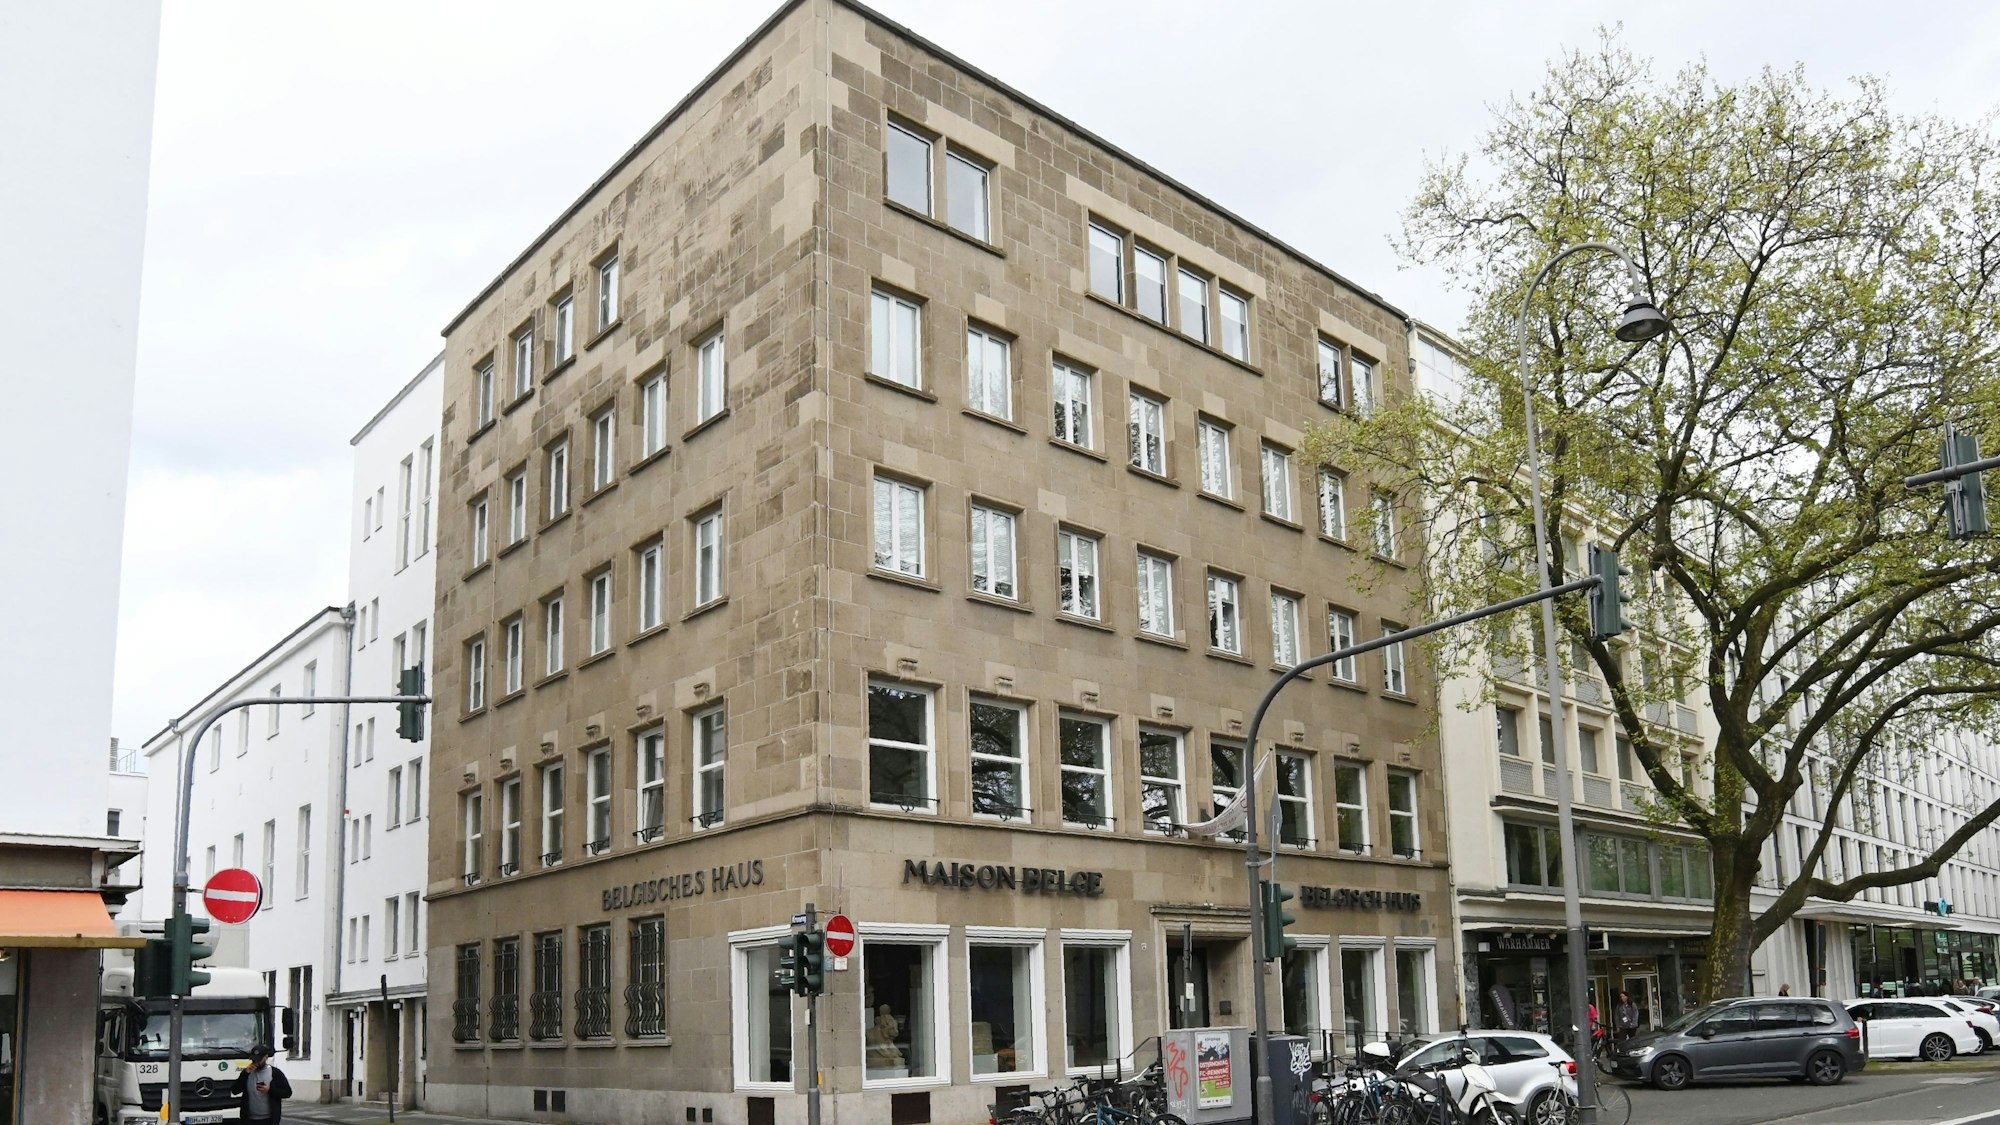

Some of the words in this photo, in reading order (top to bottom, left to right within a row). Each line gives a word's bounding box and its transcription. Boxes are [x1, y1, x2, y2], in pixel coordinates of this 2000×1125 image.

[602, 870, 705, 912] BELGISCHES
[711, 859, 764, 893] HAUS
[903, 859, 1016, 890] MAISON
[1022, 867, 1105, 897] BELGE
[1300, 886, 1382, 910] BELGISCH
[1385, 892, 1421, 913] HUIS
[1497, 936, 1551, 950] WARHAMMER
[139, 1064, 159, 1074] 328
